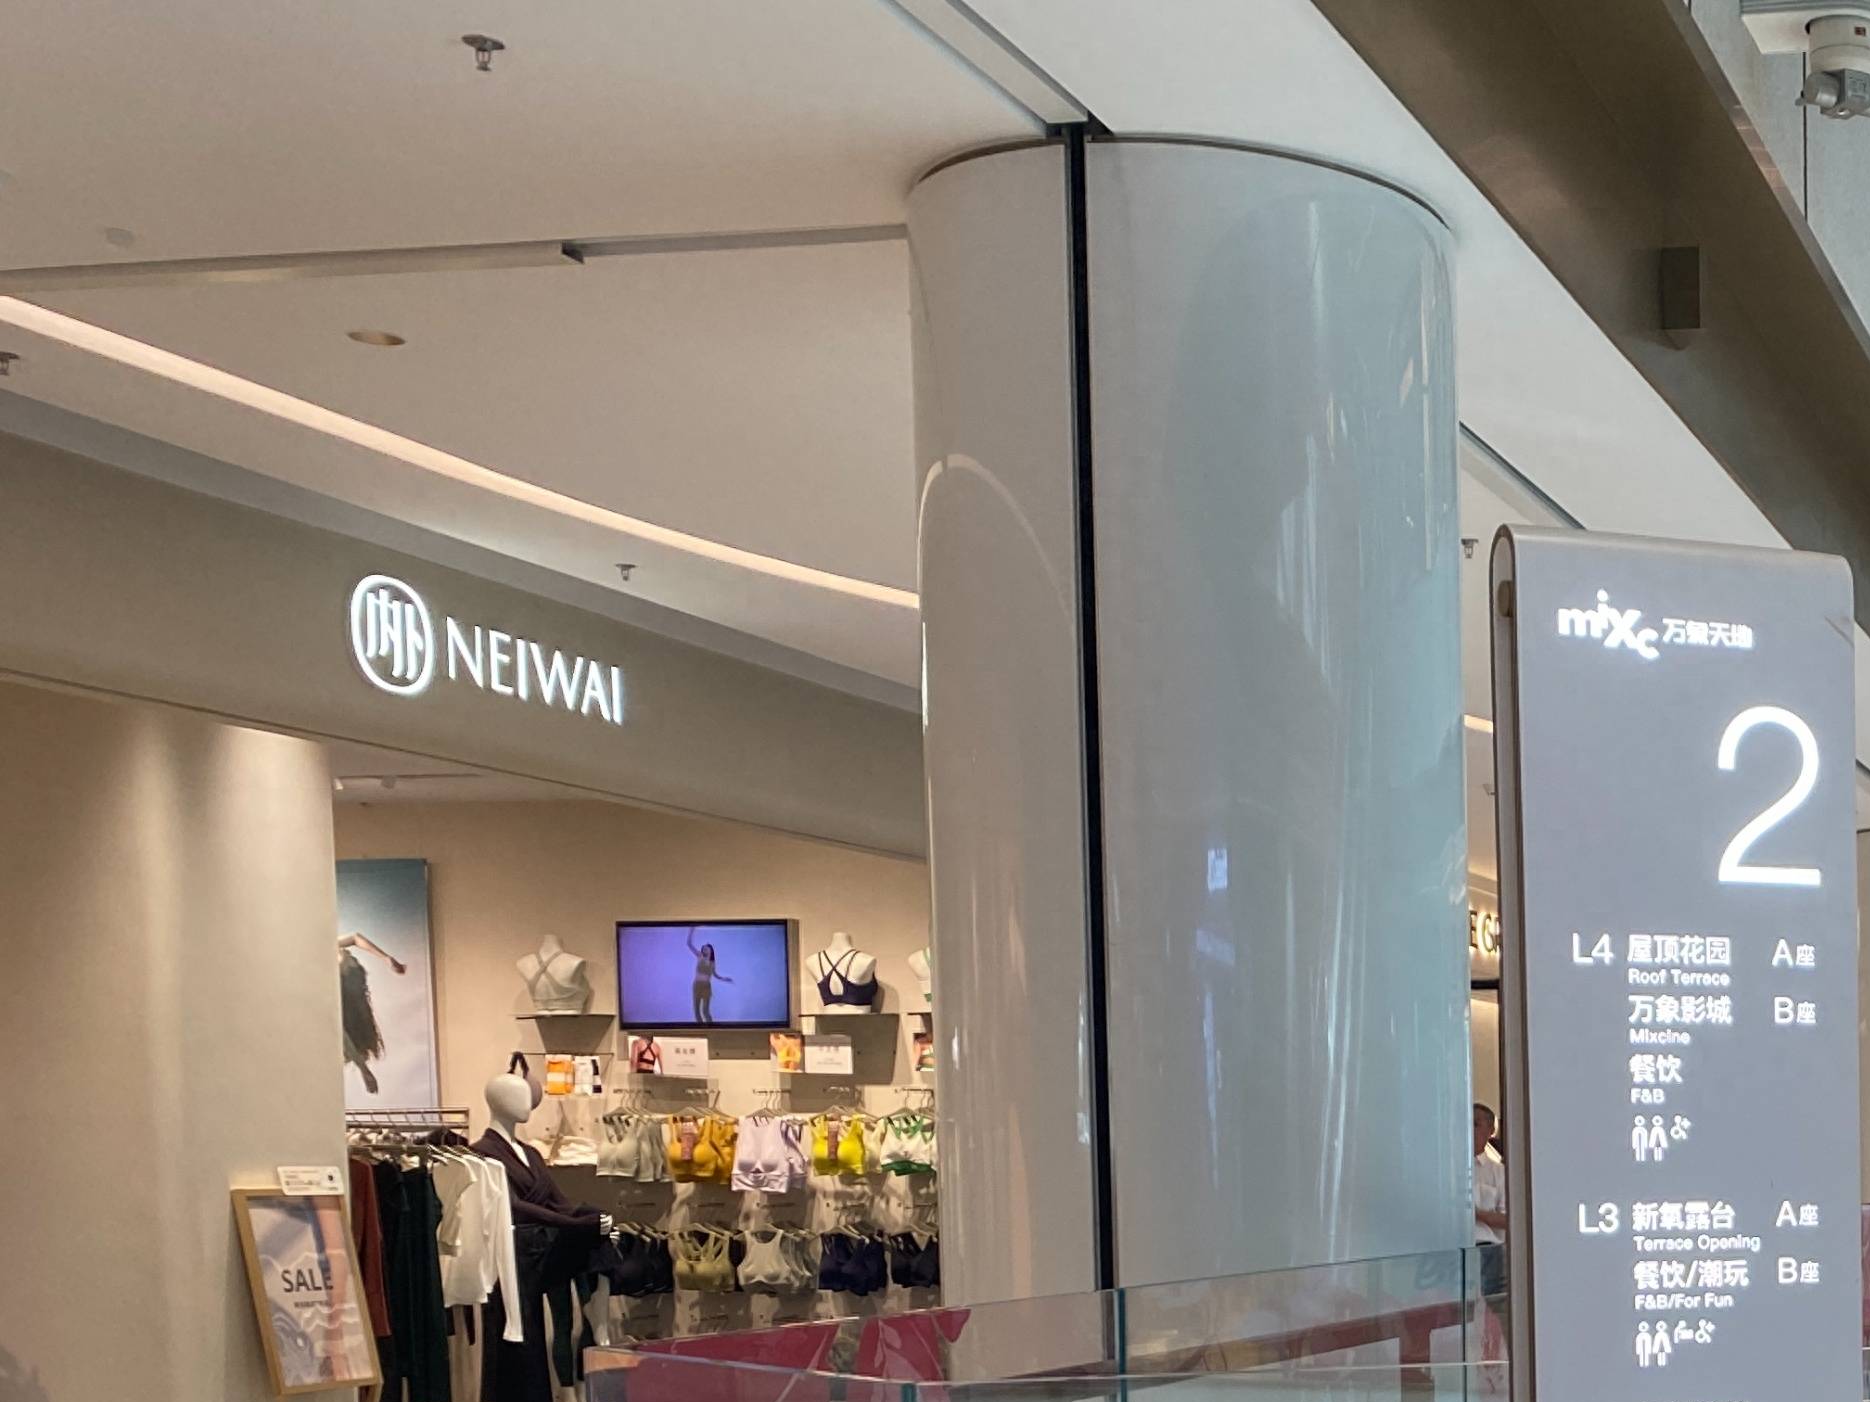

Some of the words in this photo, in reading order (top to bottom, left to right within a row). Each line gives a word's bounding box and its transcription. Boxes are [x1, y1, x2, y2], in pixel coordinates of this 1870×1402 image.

[446, 616, 626, 726] NEIWAI
[1718, 705, 1821, 886] 2
[1573, 933, 1614, 965] L4
[1627, 934, 1732, 966] 屋顶花园
[1628, 970, 1667, 986] Roof
[1671, 970, 1731, 987] Terrace
[1628, 995, 1733, 1025] 万象影城
[1630, 1029, 1691, 1045] Mixcine
[1629, 1055, 1683, 1084] 餐饮
[1630, 1090, 1665, 1106] F&B
[1578, 1202, 1621, 1234] L3
[1633, 1235, 1693, 1252] Terrace
[1697, 1234, 1762, 1253] Opening
[281, 1269, 334, 1293] SALE
[1634, 1259, 1750, 1290] 餐饮/潮玩
[1634, 1293, 1701, 1310] F&B/For
[1704, 1291, 1735, 1309] Fun
